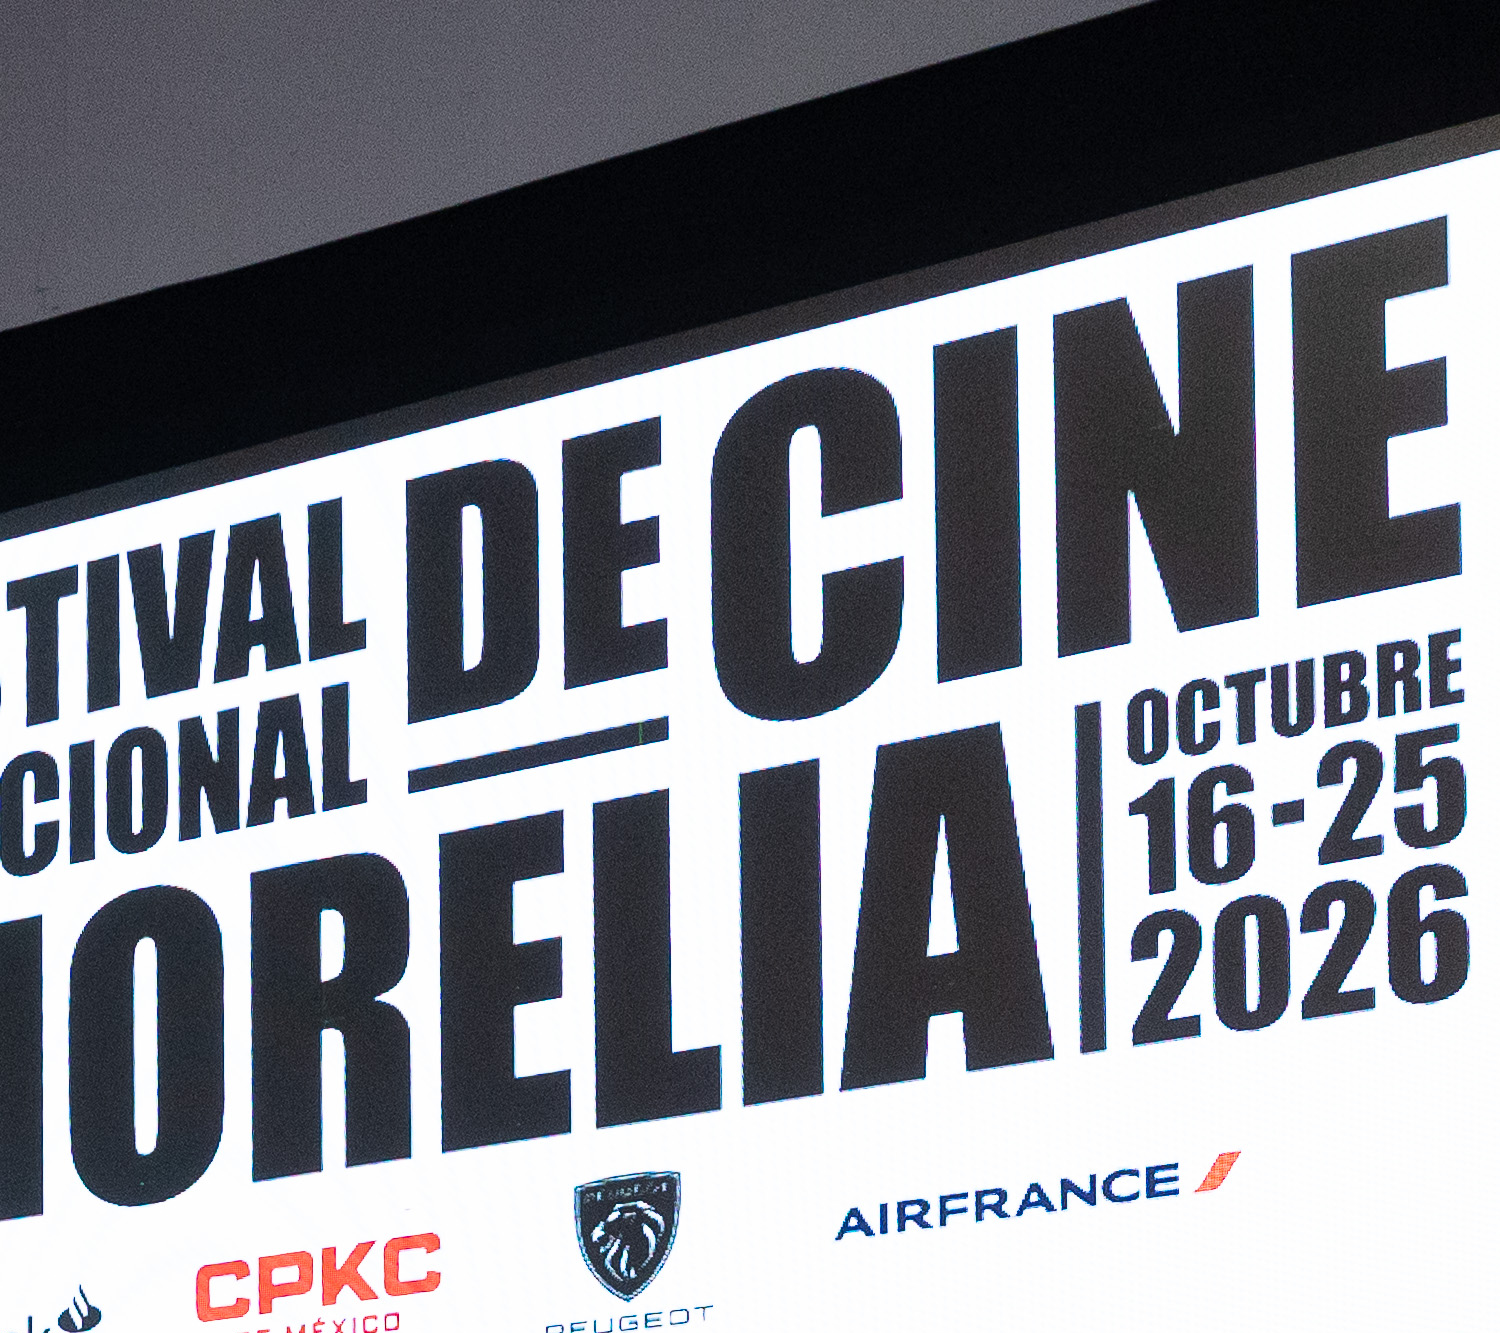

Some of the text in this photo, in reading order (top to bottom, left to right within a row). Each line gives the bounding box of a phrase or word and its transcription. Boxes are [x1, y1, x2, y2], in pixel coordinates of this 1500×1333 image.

[406, 215, 1462, 725] DE CINE
[1127, 629, 1464, 766] OCTUBRE
[1129, 724, 1467, 895] 16-25
[1131, 864, 1470, 1046] 2026
[196, 1232, 441, 1322] CPKC
